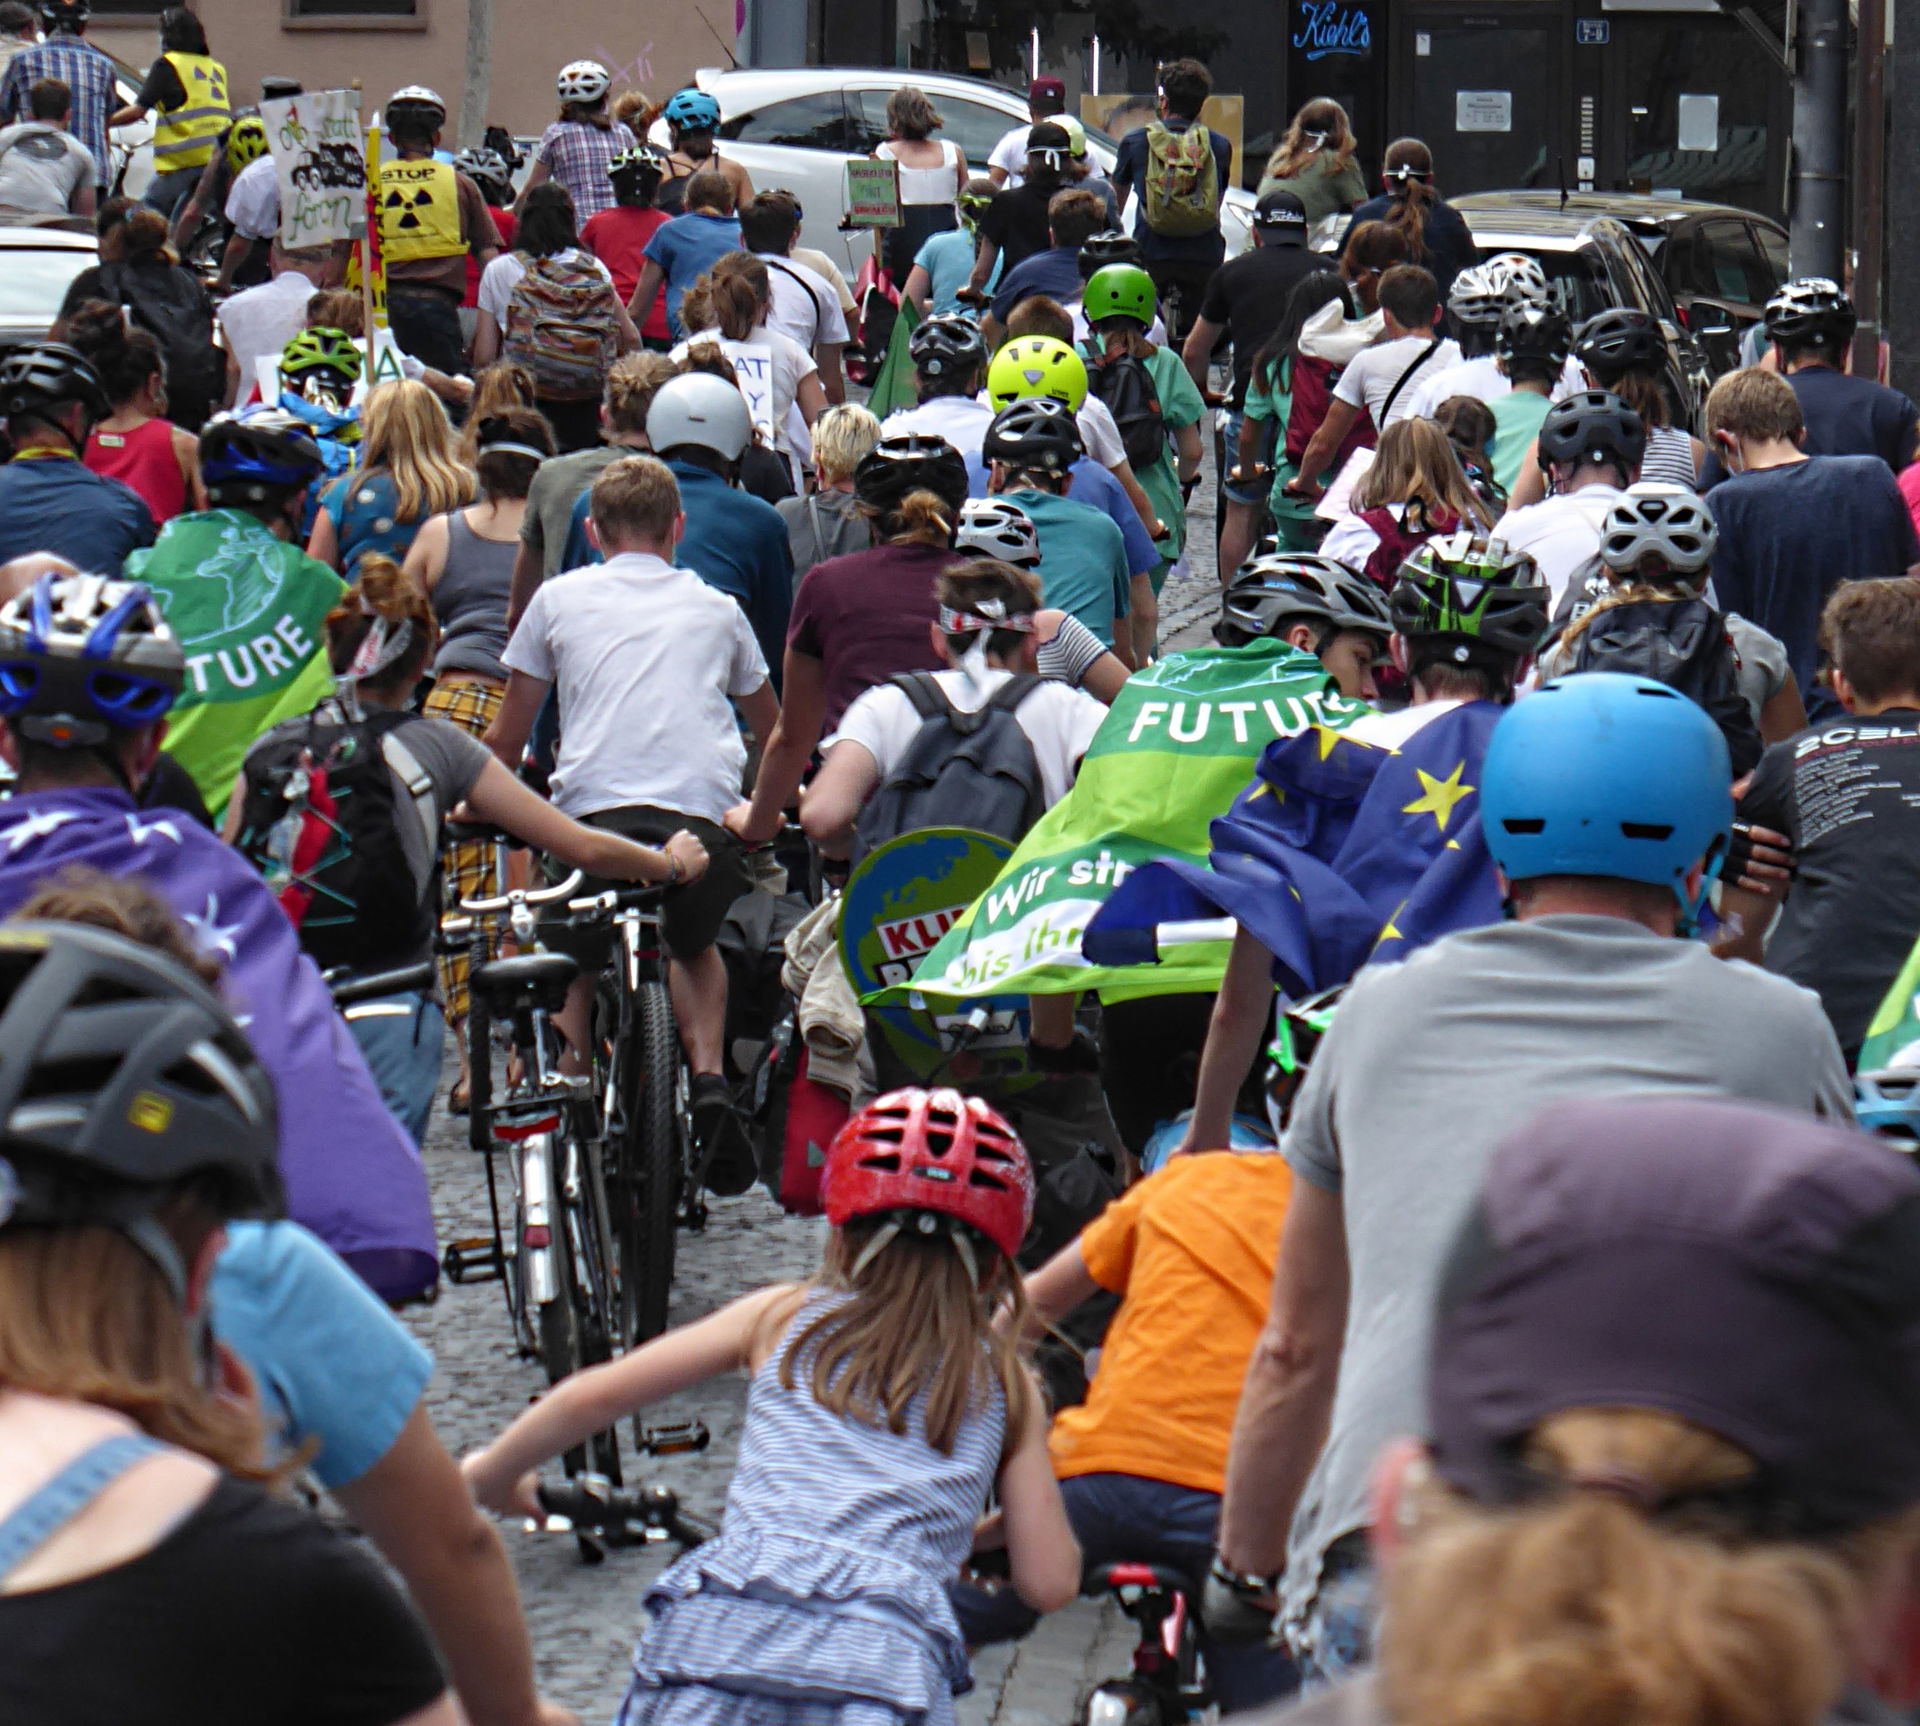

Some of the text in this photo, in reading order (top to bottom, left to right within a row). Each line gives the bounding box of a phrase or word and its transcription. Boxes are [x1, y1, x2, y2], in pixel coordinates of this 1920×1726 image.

[380, 167, 436, 180] STOP
[987, 865, 1056, 924] Wir
[883, 908, 965, 955] KLI
